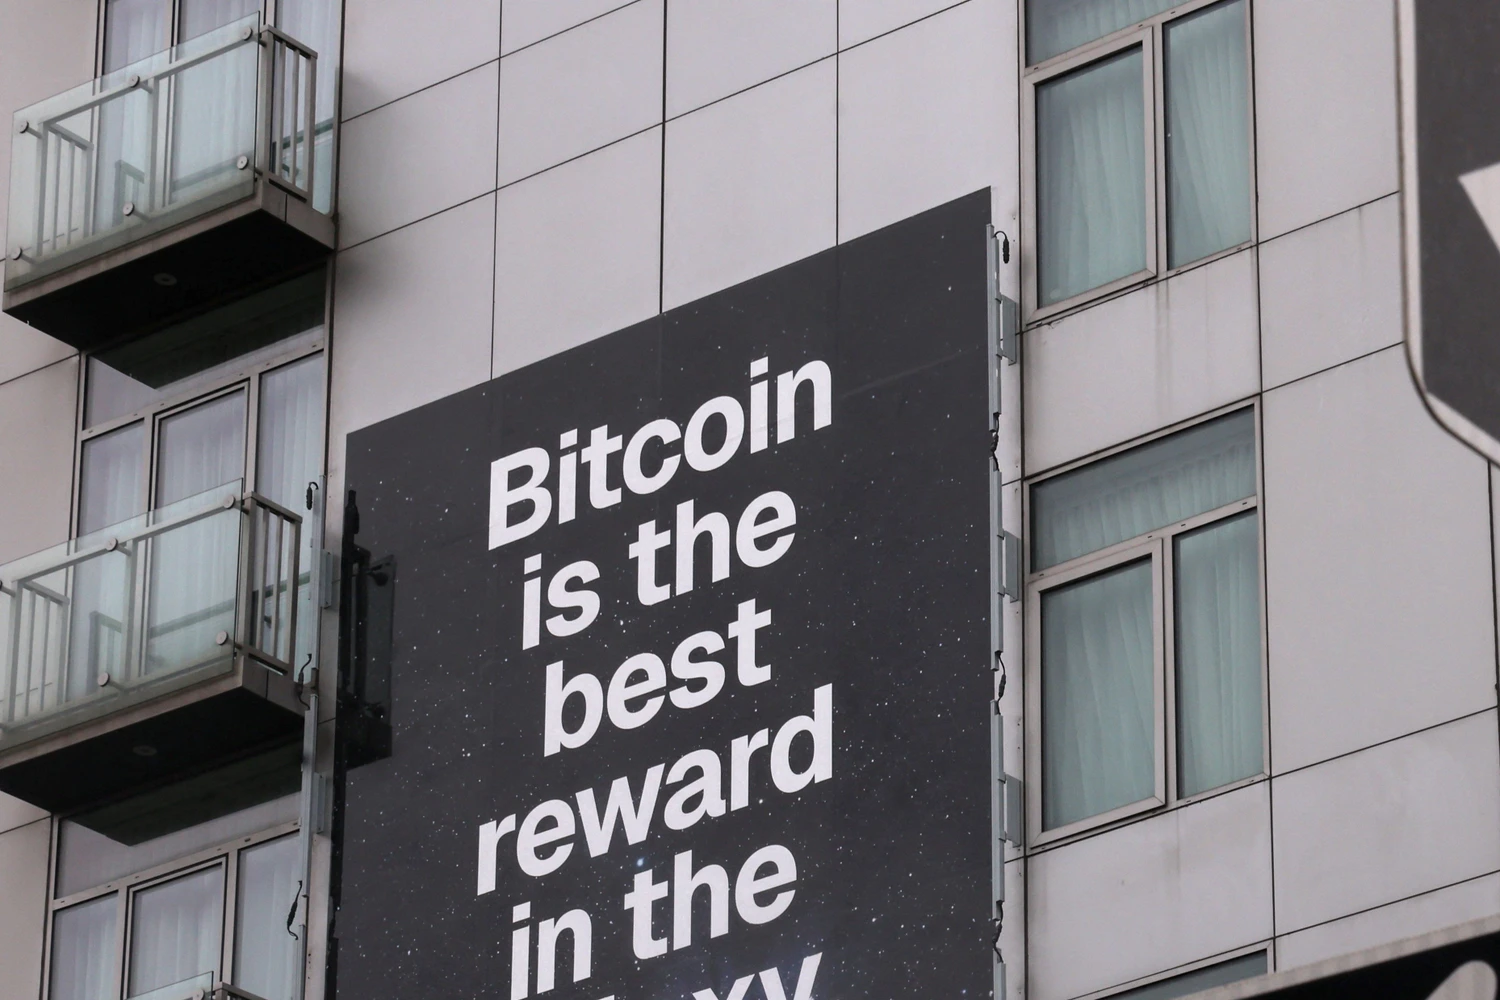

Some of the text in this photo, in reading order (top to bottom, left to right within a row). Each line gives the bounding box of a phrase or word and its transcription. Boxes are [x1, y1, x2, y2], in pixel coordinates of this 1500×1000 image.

[489, 356, 832, 550] Bitcoin
[523, 490, 797, 651] is the
[544, 598, 772, 758] best
[477, 683, 833, 896] reward
[624, 844, 797, 959] the
